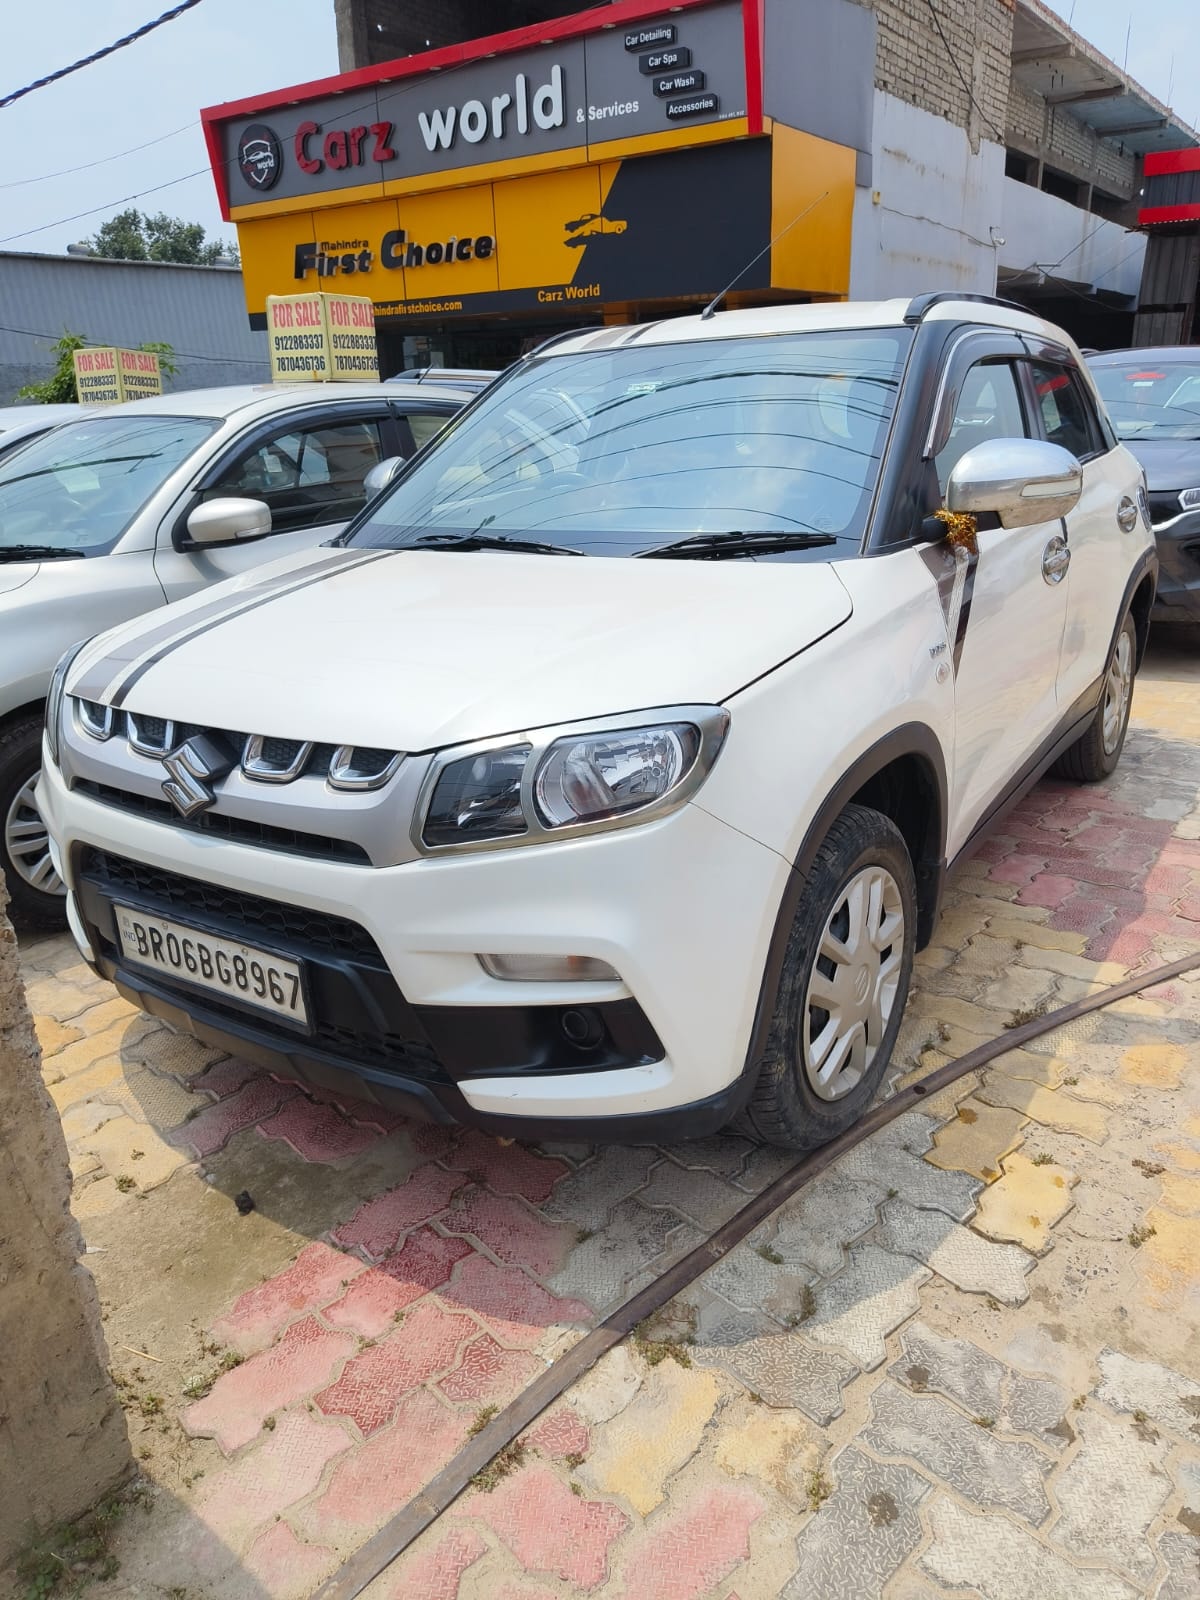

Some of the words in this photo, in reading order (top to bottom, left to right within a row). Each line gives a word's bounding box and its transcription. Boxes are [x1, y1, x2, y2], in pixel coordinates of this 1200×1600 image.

[625, 34, 638, 46] Car
[639, 28, 672, 43] Detailing
[648, 55, 662, 67] Car
[662, 53, 678, 66] Spa
[659, 80, 673, 91] Car
[674, 75, 695, 89] Wash
[576, 108, 585, 123] &
[588, 100, 640, 121] Services
[668, 98, 714, 115] Accessories
[294, 120, 399, 174] Carz
[417, 64, 566, 151] world
[294, 242, 374, 279] First
[380, 229, 495, 270] Choice
[320, 239, 369, 251] Mahindra
[537, 290, 563, 303] Carz
[565, 283, 600, 300] World
[272, 303, 294, 328] FOR
[295, 301, 321, 327] SALE
[329, 301, 350, 327] FOR
[352, 302, 375, 328] SALE
[374, 301, 463, 316] hindrafirstchoice.com
[274, 334, 323, 351] 9122883337
[77, 354, 94, 372] FOR
[95, 352, 114, 370] SALE
[121, 352, 138, 370] FOR
[138, 354, 157, 373] SALE
[276, 356, 326, 372] 7870436736
[133, 922, 299, 1010] BR06BG8967
